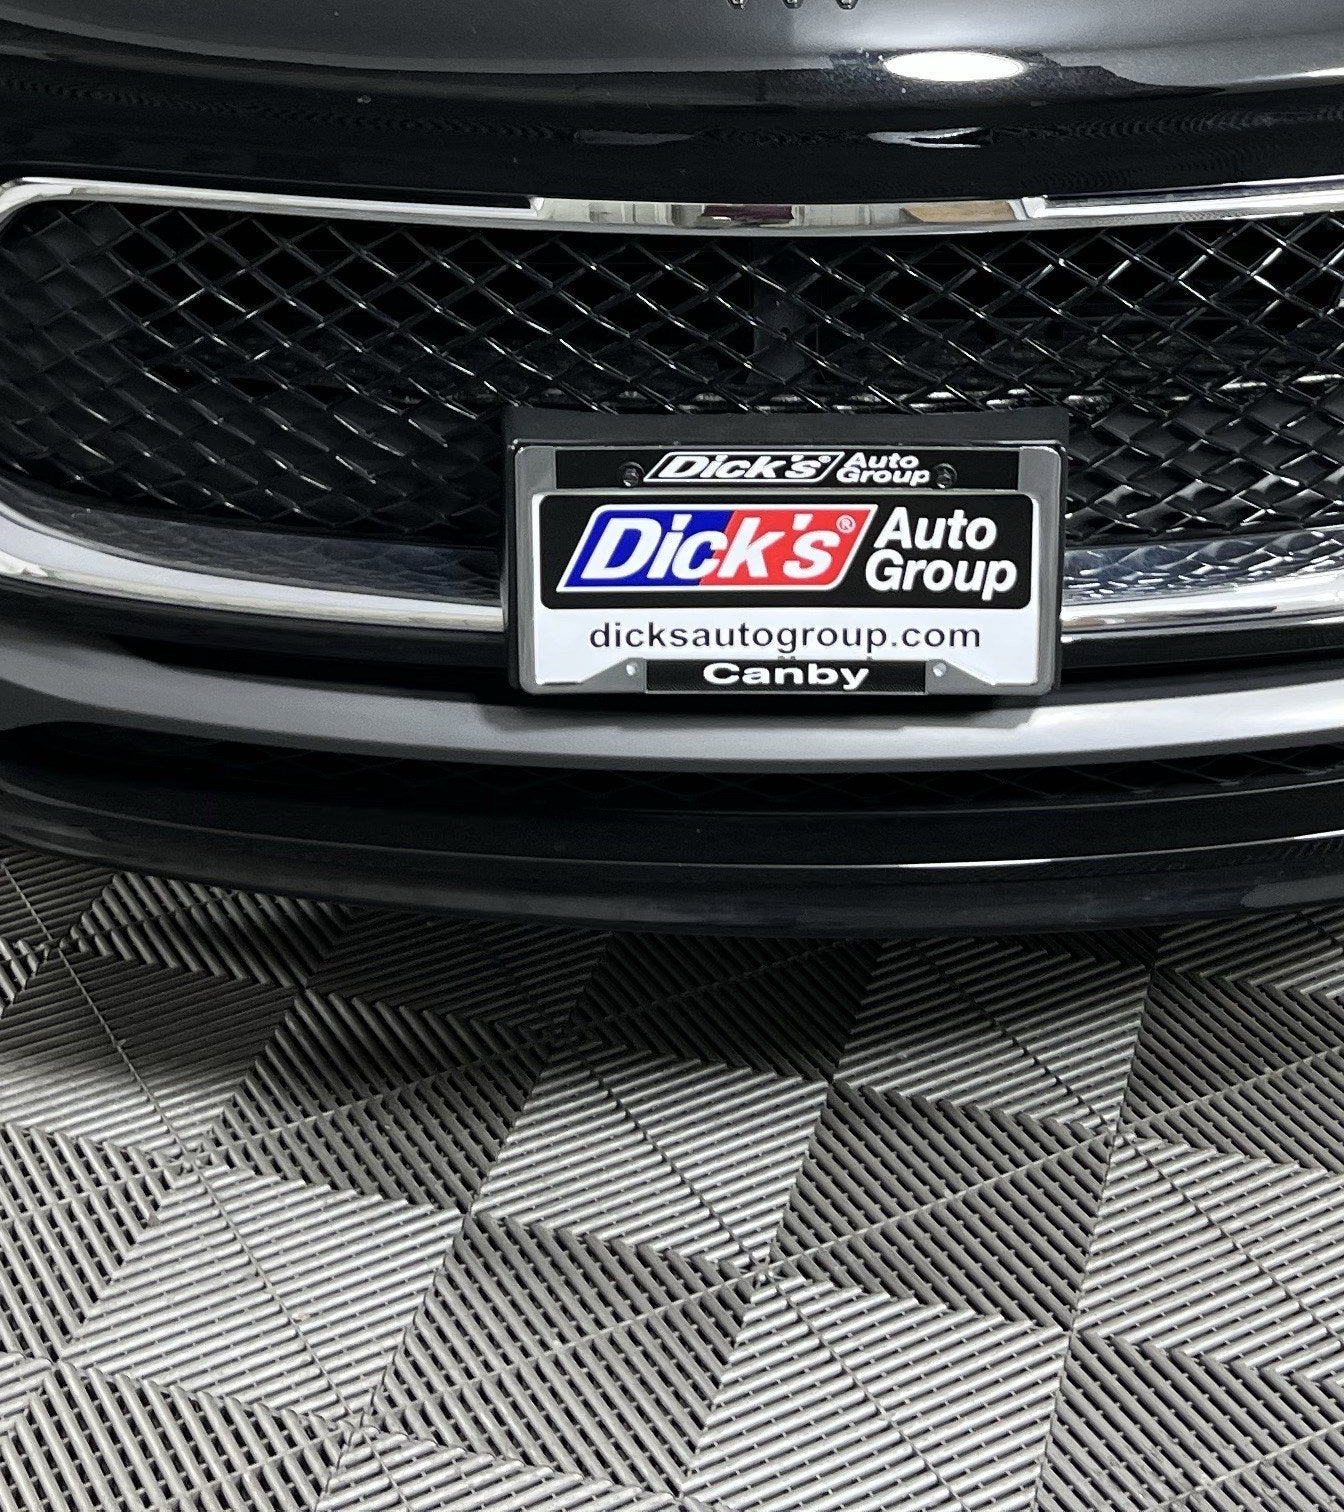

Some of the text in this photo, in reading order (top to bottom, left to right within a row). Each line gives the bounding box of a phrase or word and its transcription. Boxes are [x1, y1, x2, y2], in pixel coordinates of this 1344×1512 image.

[658, 452, 920, 479] Dick's Auto
[836, 467, 931, 487] Group
[580, 507, 998, 580] Dick's Auto
[864, 551, 1018, 601] Group
[589, 621, 981, 654] dicksautogroup.com
[702, 662, 870, 690] Canby
